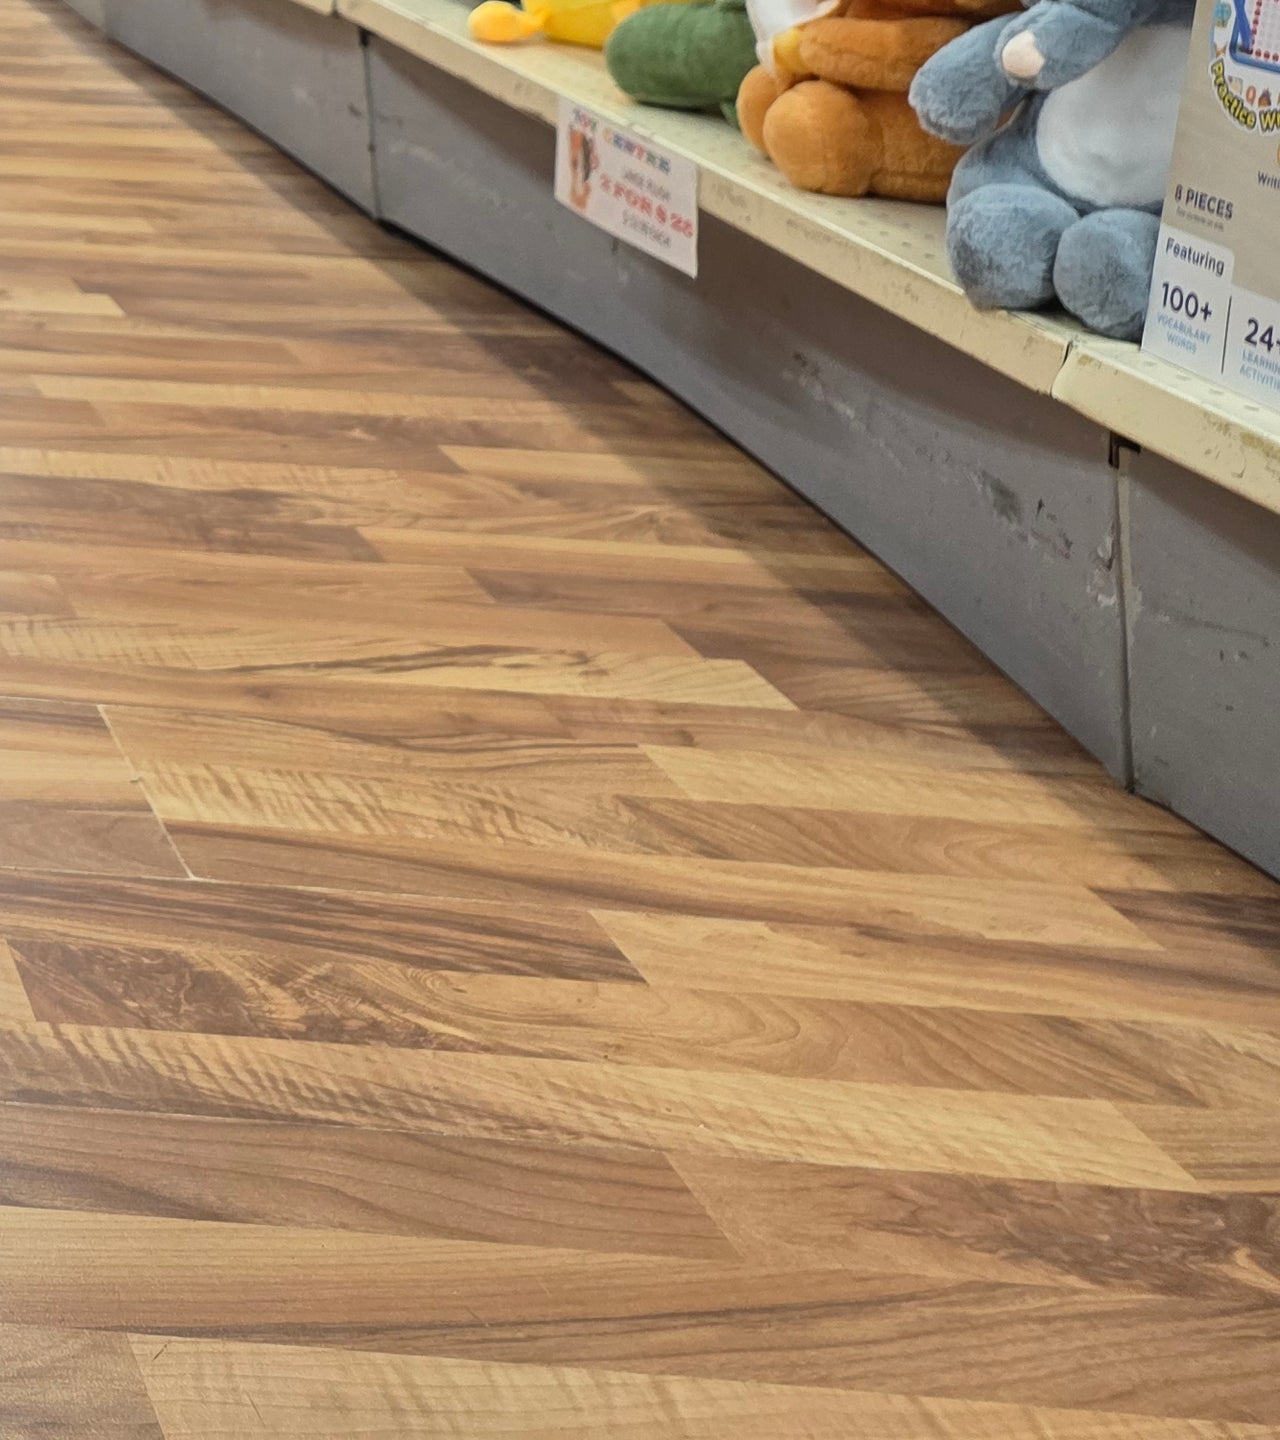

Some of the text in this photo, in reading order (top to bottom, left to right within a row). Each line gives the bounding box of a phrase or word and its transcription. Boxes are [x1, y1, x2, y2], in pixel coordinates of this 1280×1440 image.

[1211, 58, 1257, 130] Practice
[1186, 189, 1233, 220] PIECES
[1166, 237, 1225, 278] Featuring
[1162, 281, 1212, 322] 100+
[1157, 313, 1280, 375] VOCABULARY LEARNIN
[1166, 332, 1198, 355] WORDS
[1240, 363, 1280, 392] ACTIVITI
